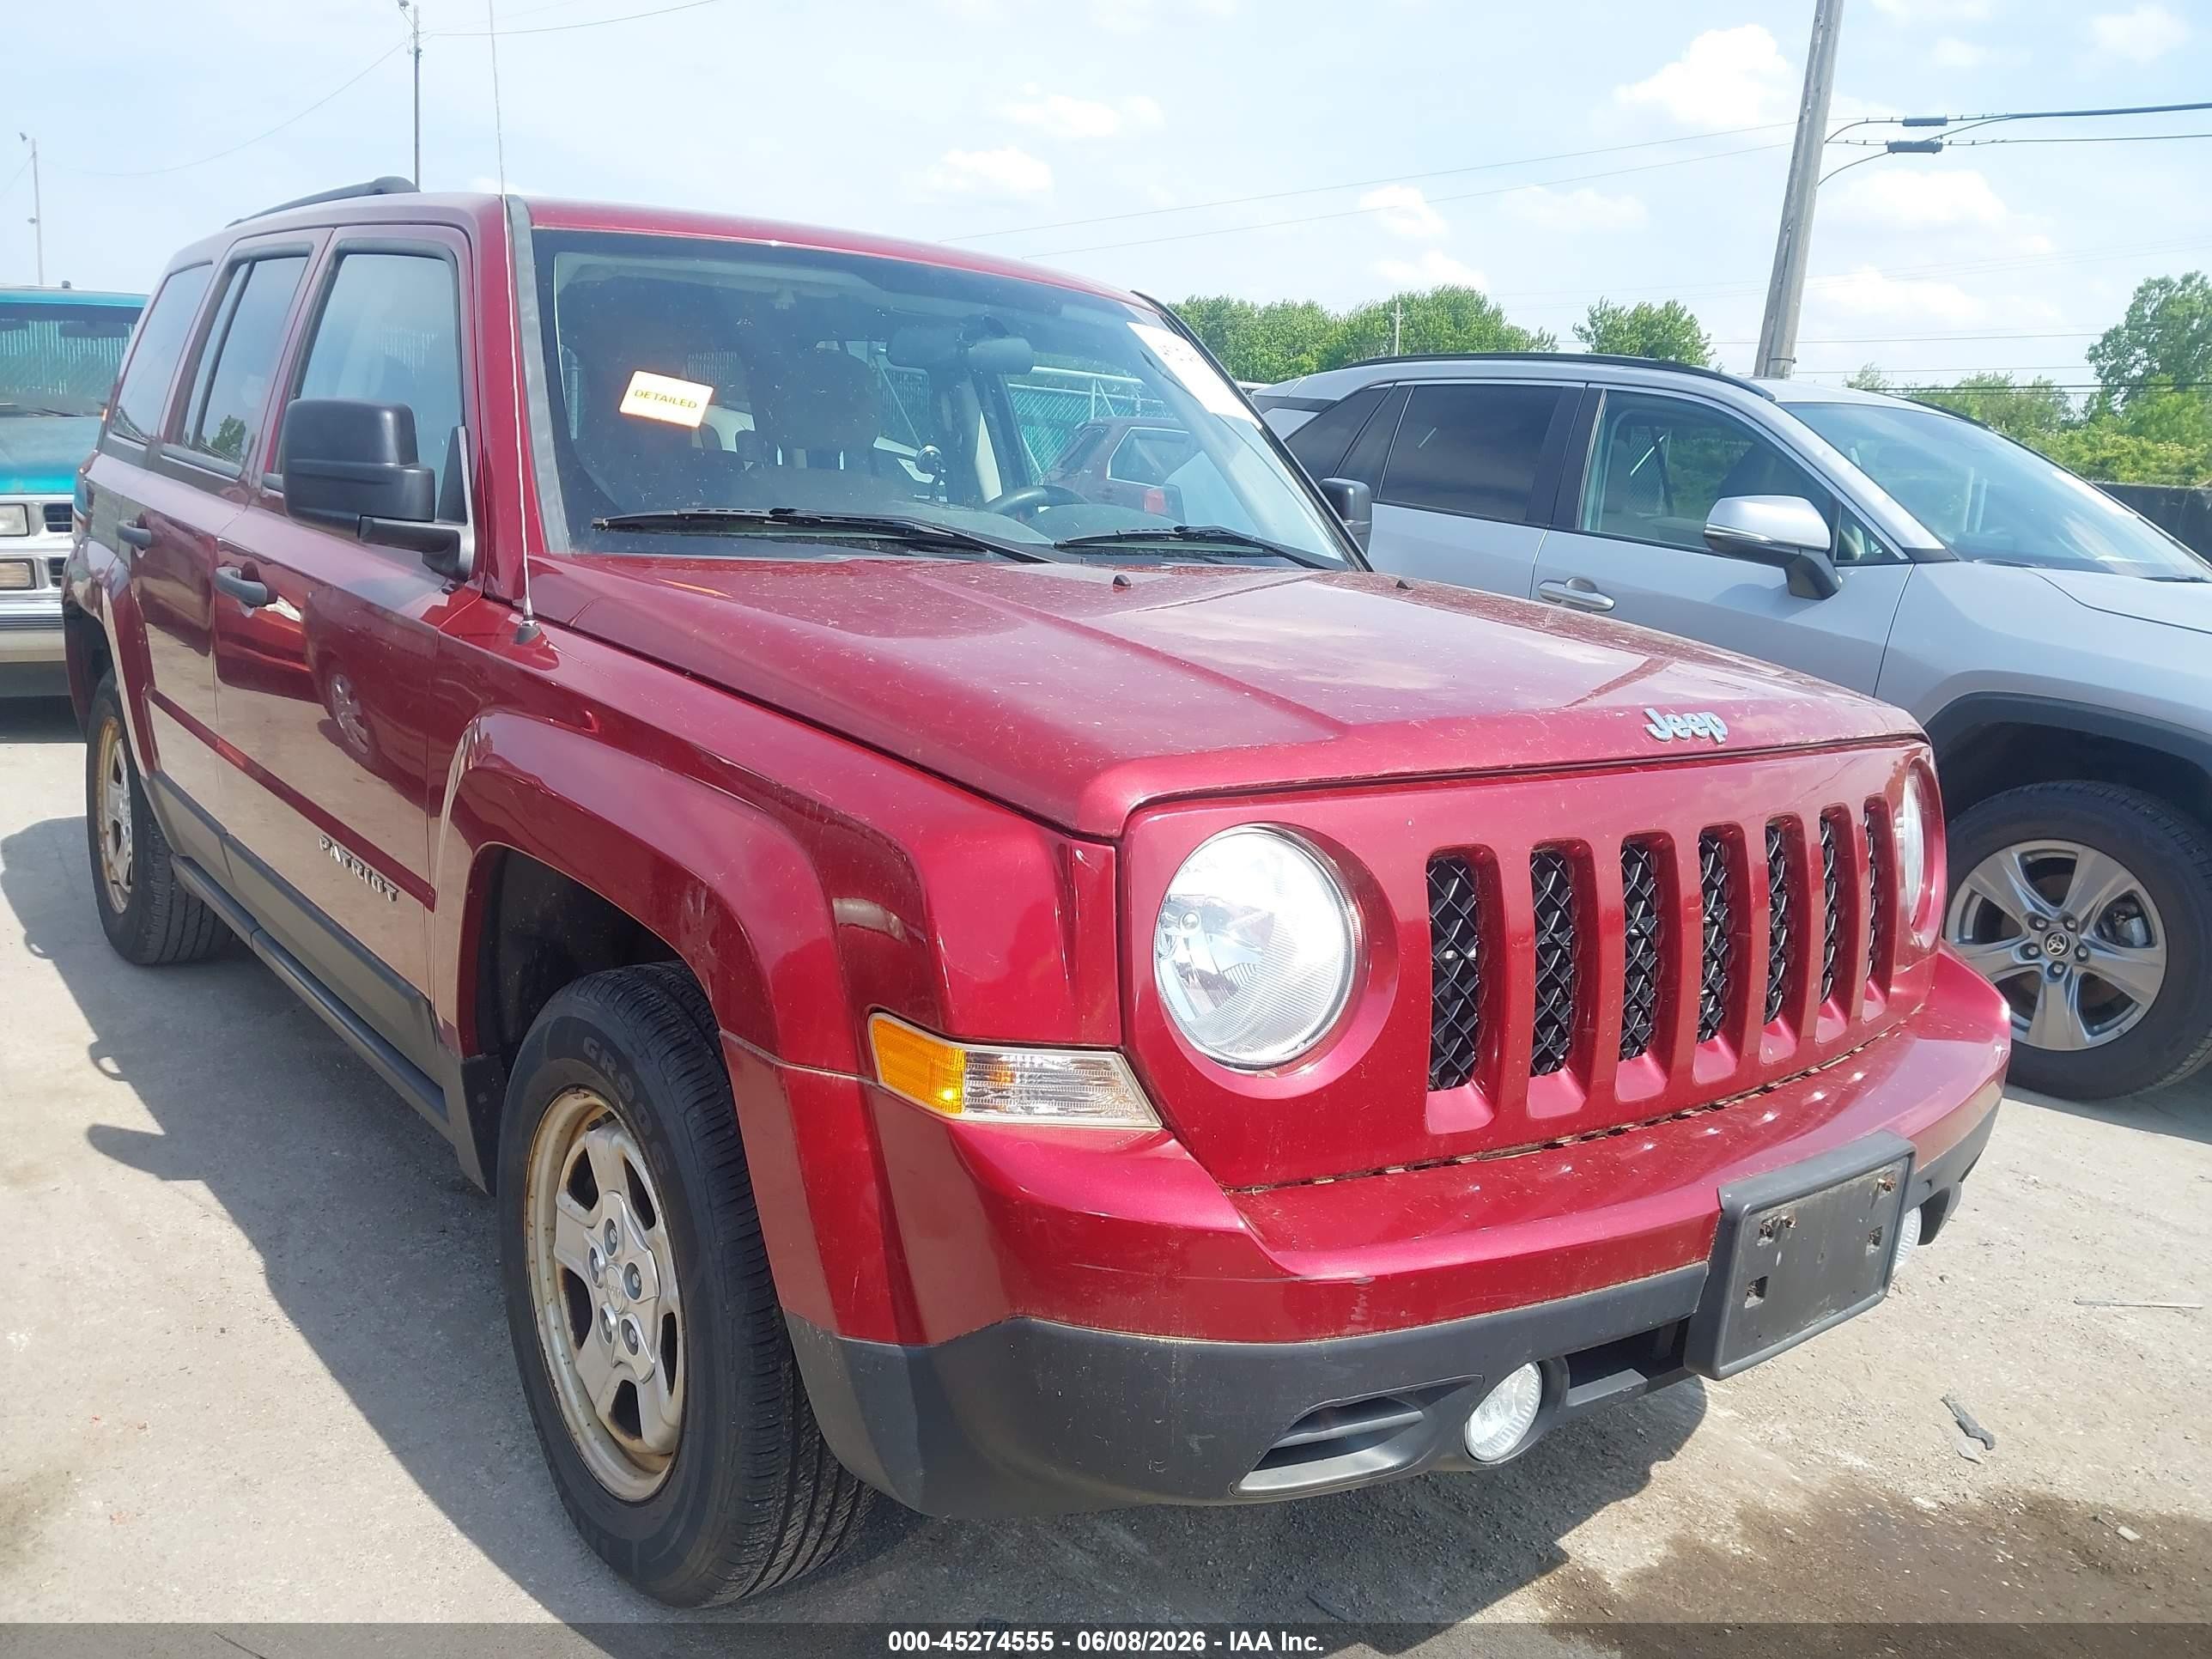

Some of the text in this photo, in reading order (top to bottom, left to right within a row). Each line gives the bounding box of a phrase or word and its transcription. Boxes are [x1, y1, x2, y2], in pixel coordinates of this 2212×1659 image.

[634, 389, 697, 409] DETAILED
[1643, 708, 1729, 744] Jeep
[319, 835, 399, 902] PATRIOT
